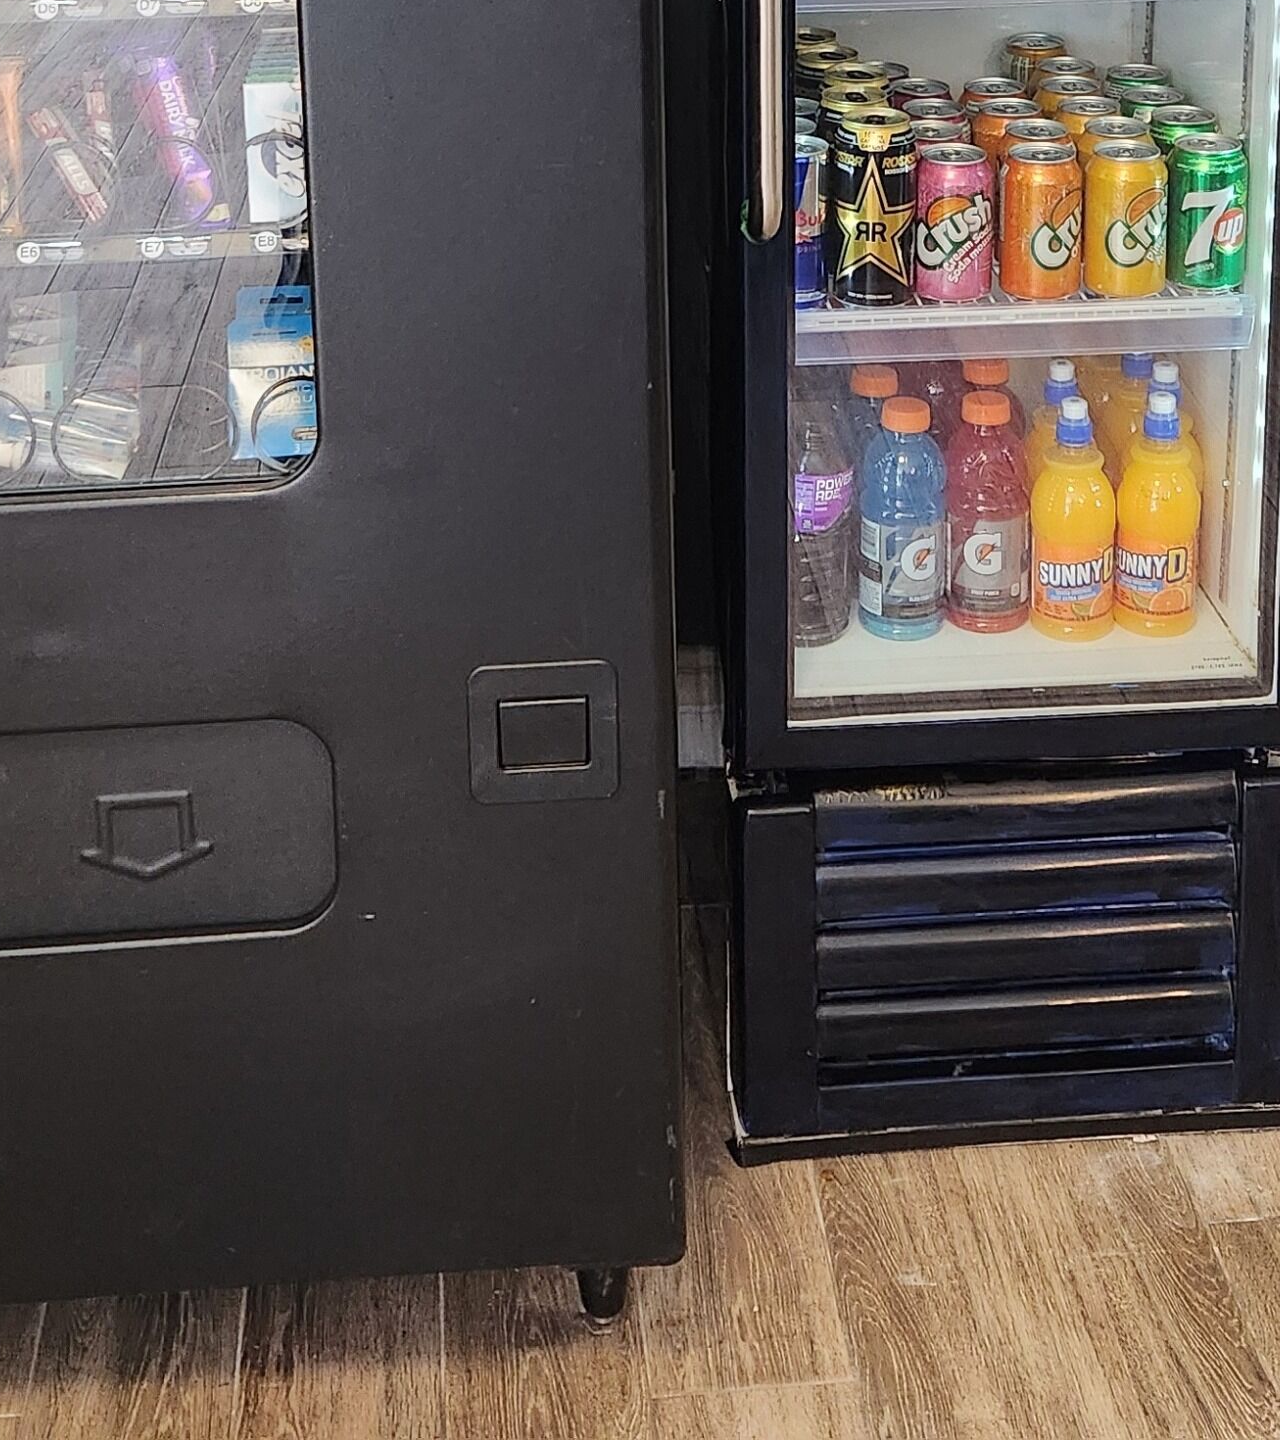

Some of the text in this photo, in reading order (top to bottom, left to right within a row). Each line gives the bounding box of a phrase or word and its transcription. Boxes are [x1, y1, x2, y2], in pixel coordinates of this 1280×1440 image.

[37, 1, 57, 15] D6
[159, 79, 184, 130] DAIRY
[258, 236, 275, 248] E8
[916, 192, 992, 267] Crush
[1181, 184, 1235, 266] 7
[20, 246, 38, 258] E6
[144, 241, 162, 253] E7
[940, 239, 975, 273] Cream
[946, 257, 971, 285] Soda
[900, 534, 937, 582] G
[963, 532, 1003, 577] G
